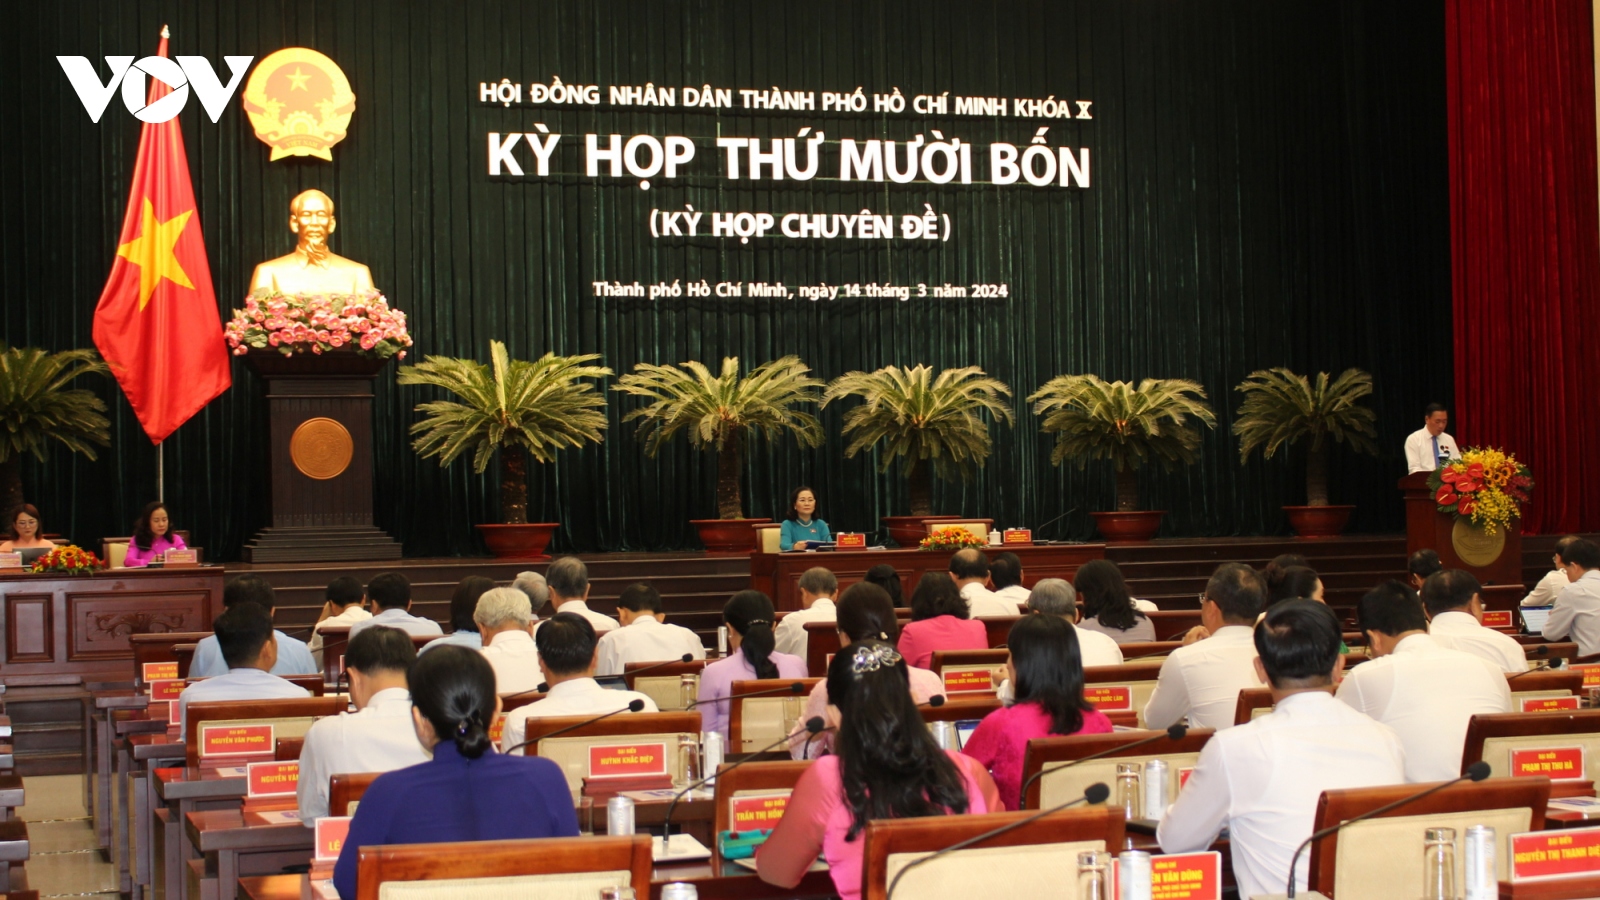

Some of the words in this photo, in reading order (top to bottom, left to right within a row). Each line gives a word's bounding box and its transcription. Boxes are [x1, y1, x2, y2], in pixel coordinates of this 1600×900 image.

[481, 79, 521, 107] HỘI
[530, 76, 600, 104] ĐỒNG
[610, 83, 675, 106] NHÂN
[683, 85, 731, 107] DÂN
[740, 87, 814, 110] THÀNH
[822, 87, 867, 112] PHỐ
[874, 87, 905, 113] HỒ
[913, 92, 948, 114] CHÍ
[955, 97, 1006, 116] MINH
[1015, 96, 1070, 118] KHÓA
[1075, 100, 1093, 119] X
[488, 124, 561, 176] KỲ
[586, 134, 695, 190] HỌP
[717, 127, 825, 181] THỨ
[840, 130, 972, 185] MƯỜI
[991, 127, 1090, 188] BỐN
[650, 204, 702, 238] (KỲ
[712, 212, 774, 244] HỌP
[781, 209, 893, 238] CHUYÊN
[901, 203, 951, 242] ĐỀ)
[593, 281, 644, 297] Thành
[650, 279, 681, 300] phố
[688, 280, 711, 297] Hồ
[716, 281, 742, 297] Chí
[749, 282, 794, 300] Minh,
[799, 283, 839, 301] ngày
[844, 284, 861, 297] 14
[865, 282, 909, 301] tháng
[917, 284, 927, 297] 3
[933, 283, 966, 297] năm
[971, 284, 1008, 298] 2024
[1522, 763, 1540, 773] PHẠM
[1551, 761, 1563, 770] THU
[768, 808, 785, 819] HỒN
[1561, 847, 1587, 859] THANH
[1162, 870, 1180, 883] VĂN
